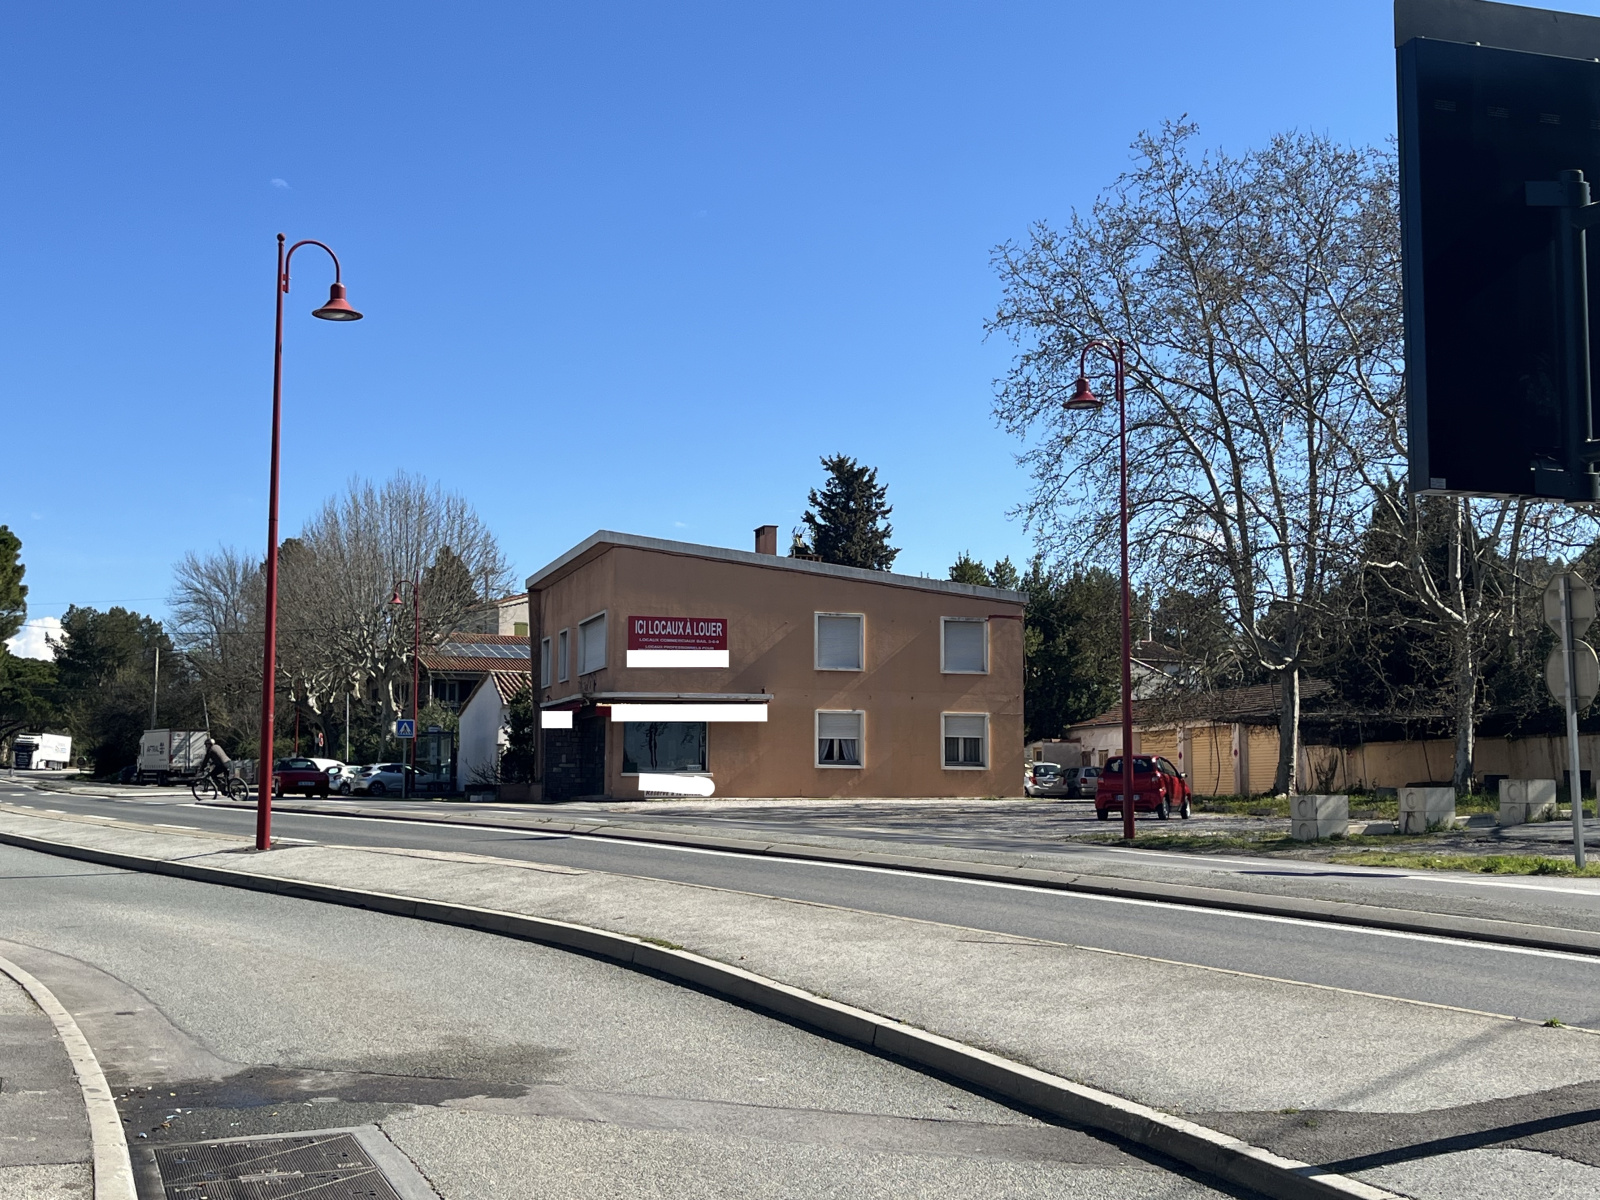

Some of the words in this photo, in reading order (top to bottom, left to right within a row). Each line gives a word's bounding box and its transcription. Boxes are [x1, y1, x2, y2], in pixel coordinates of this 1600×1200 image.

[635, 620, 646, 634] ICI
[649, 620, 684, 635] LOCAUX
[685, 618, 692, 635] À
[694, 621, 723, 636] LOUER
